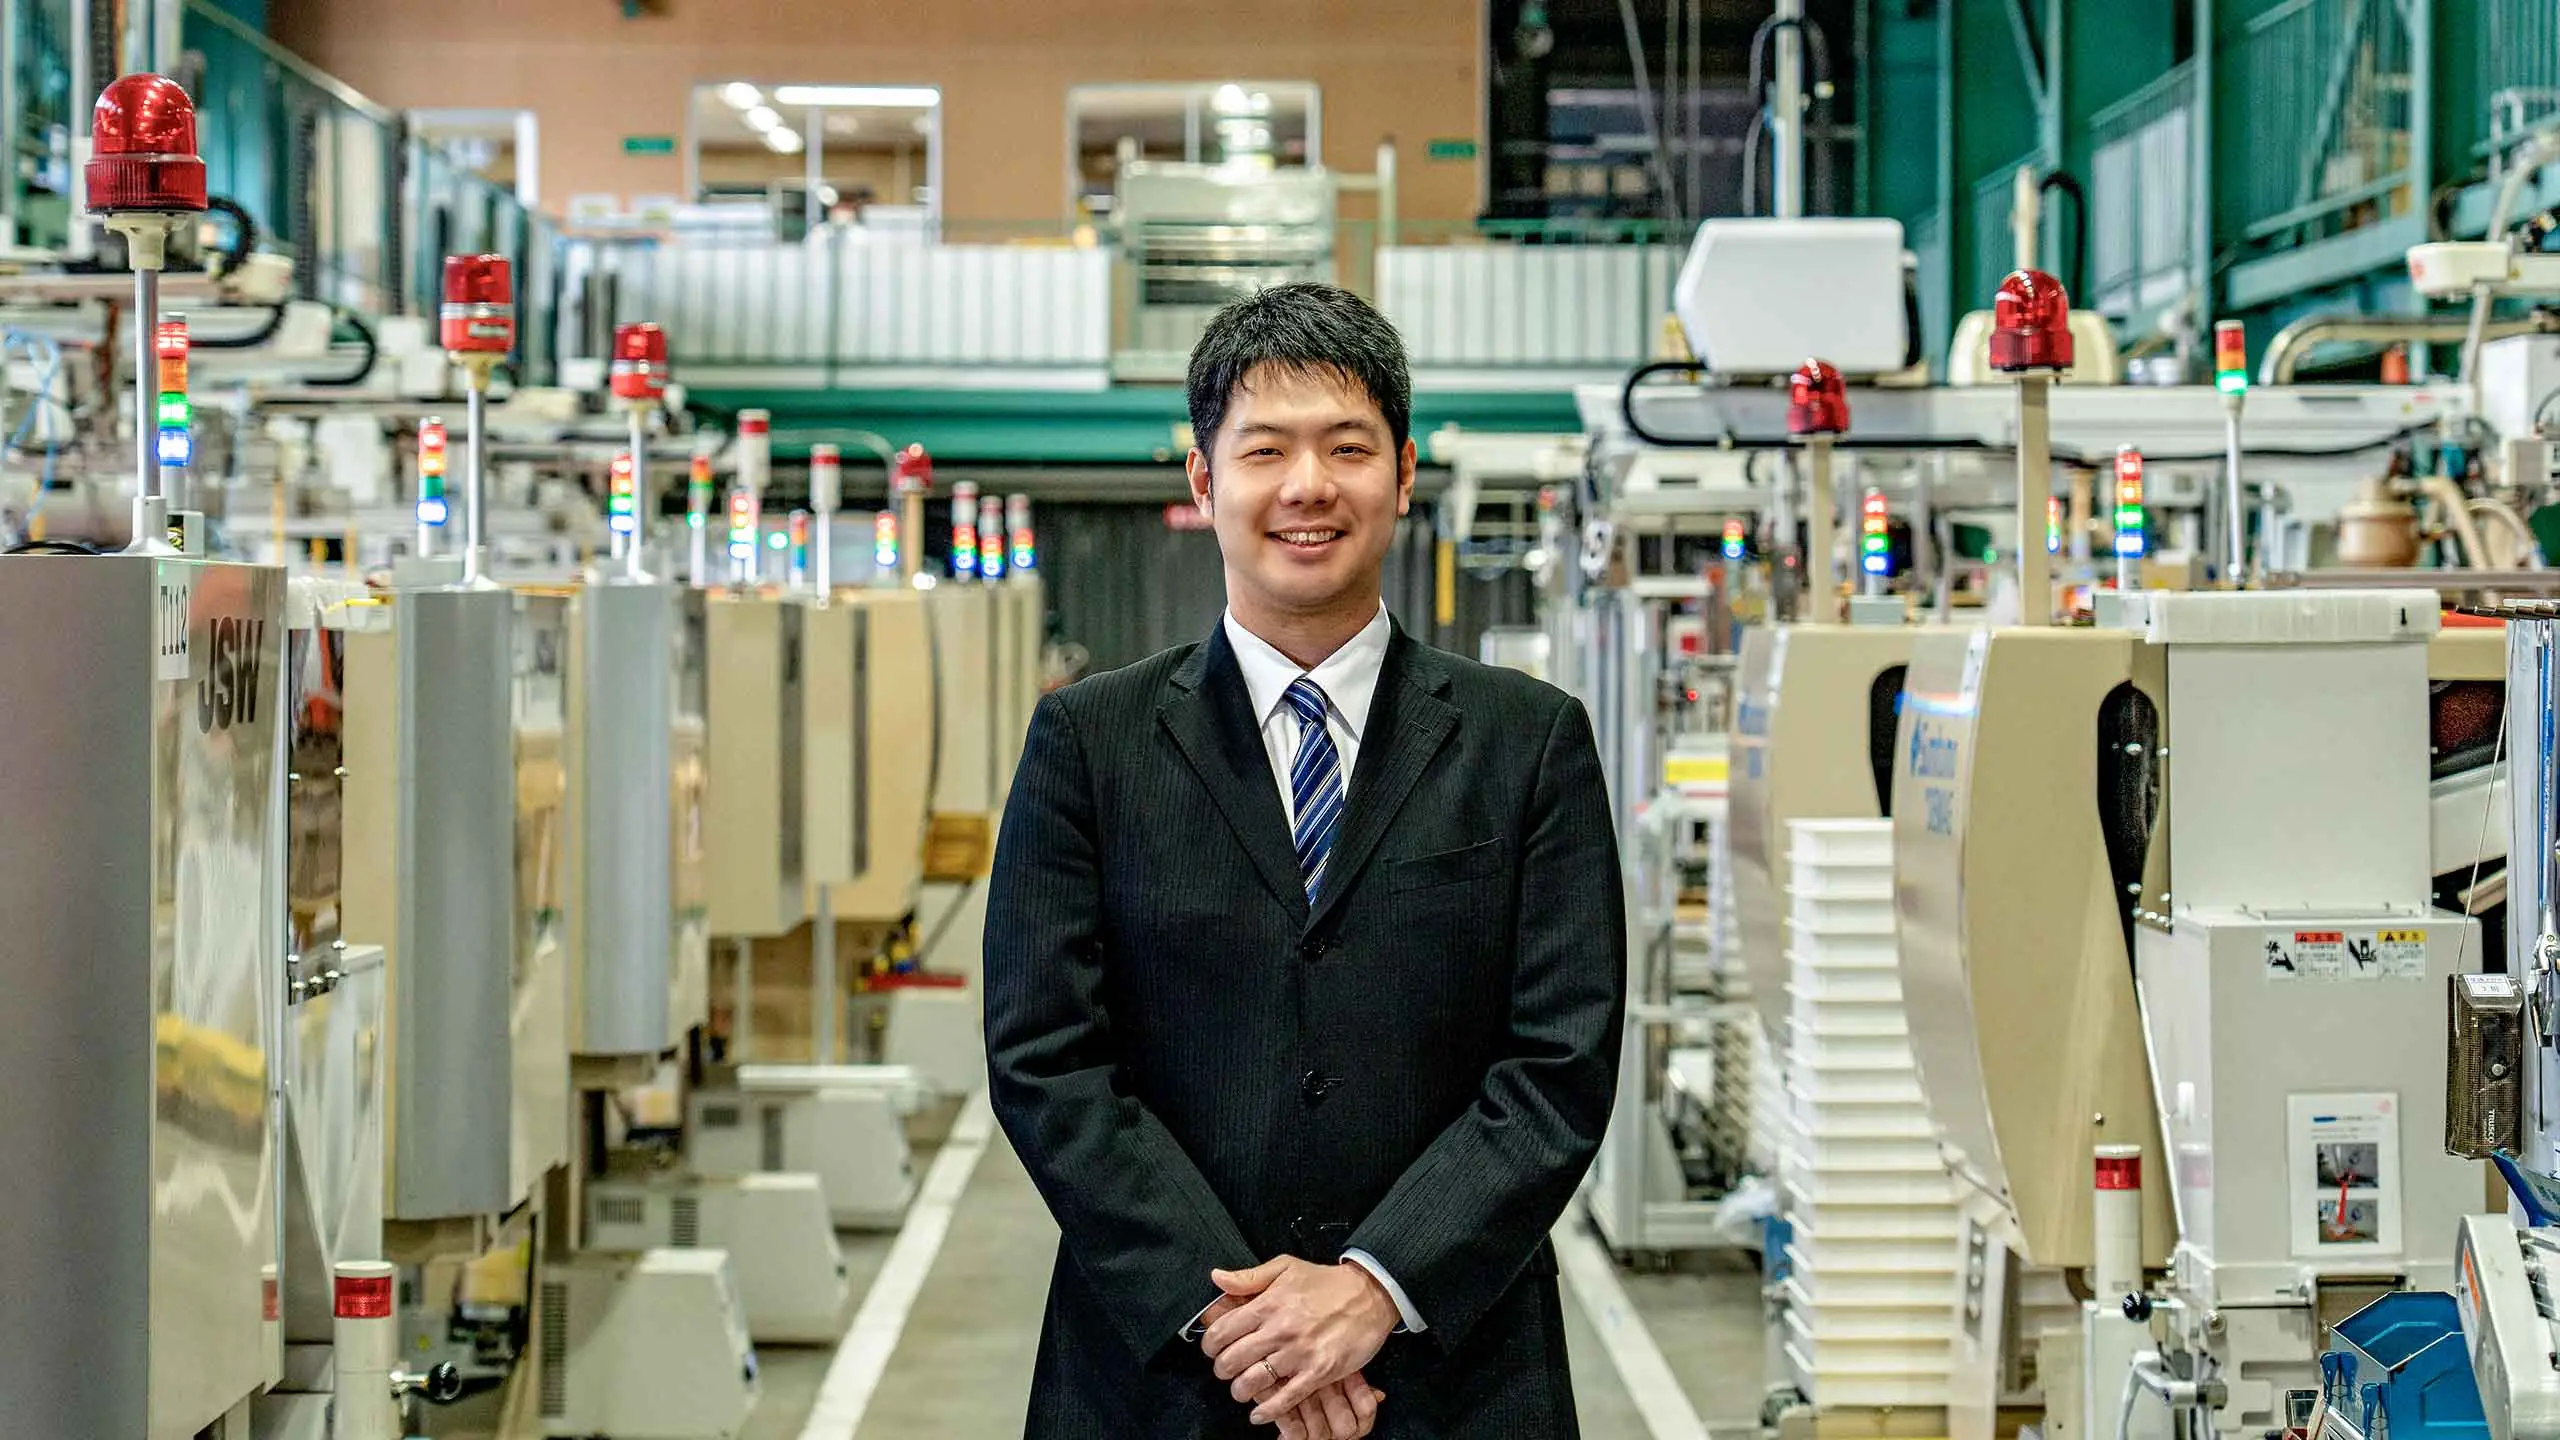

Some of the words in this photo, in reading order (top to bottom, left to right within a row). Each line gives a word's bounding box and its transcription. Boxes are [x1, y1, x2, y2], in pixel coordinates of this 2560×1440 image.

[160, 584, 187, 656] T112
[197, 616, 265, 734] JSW
[2488, 1108, 2496, 1143] TRUSCO
